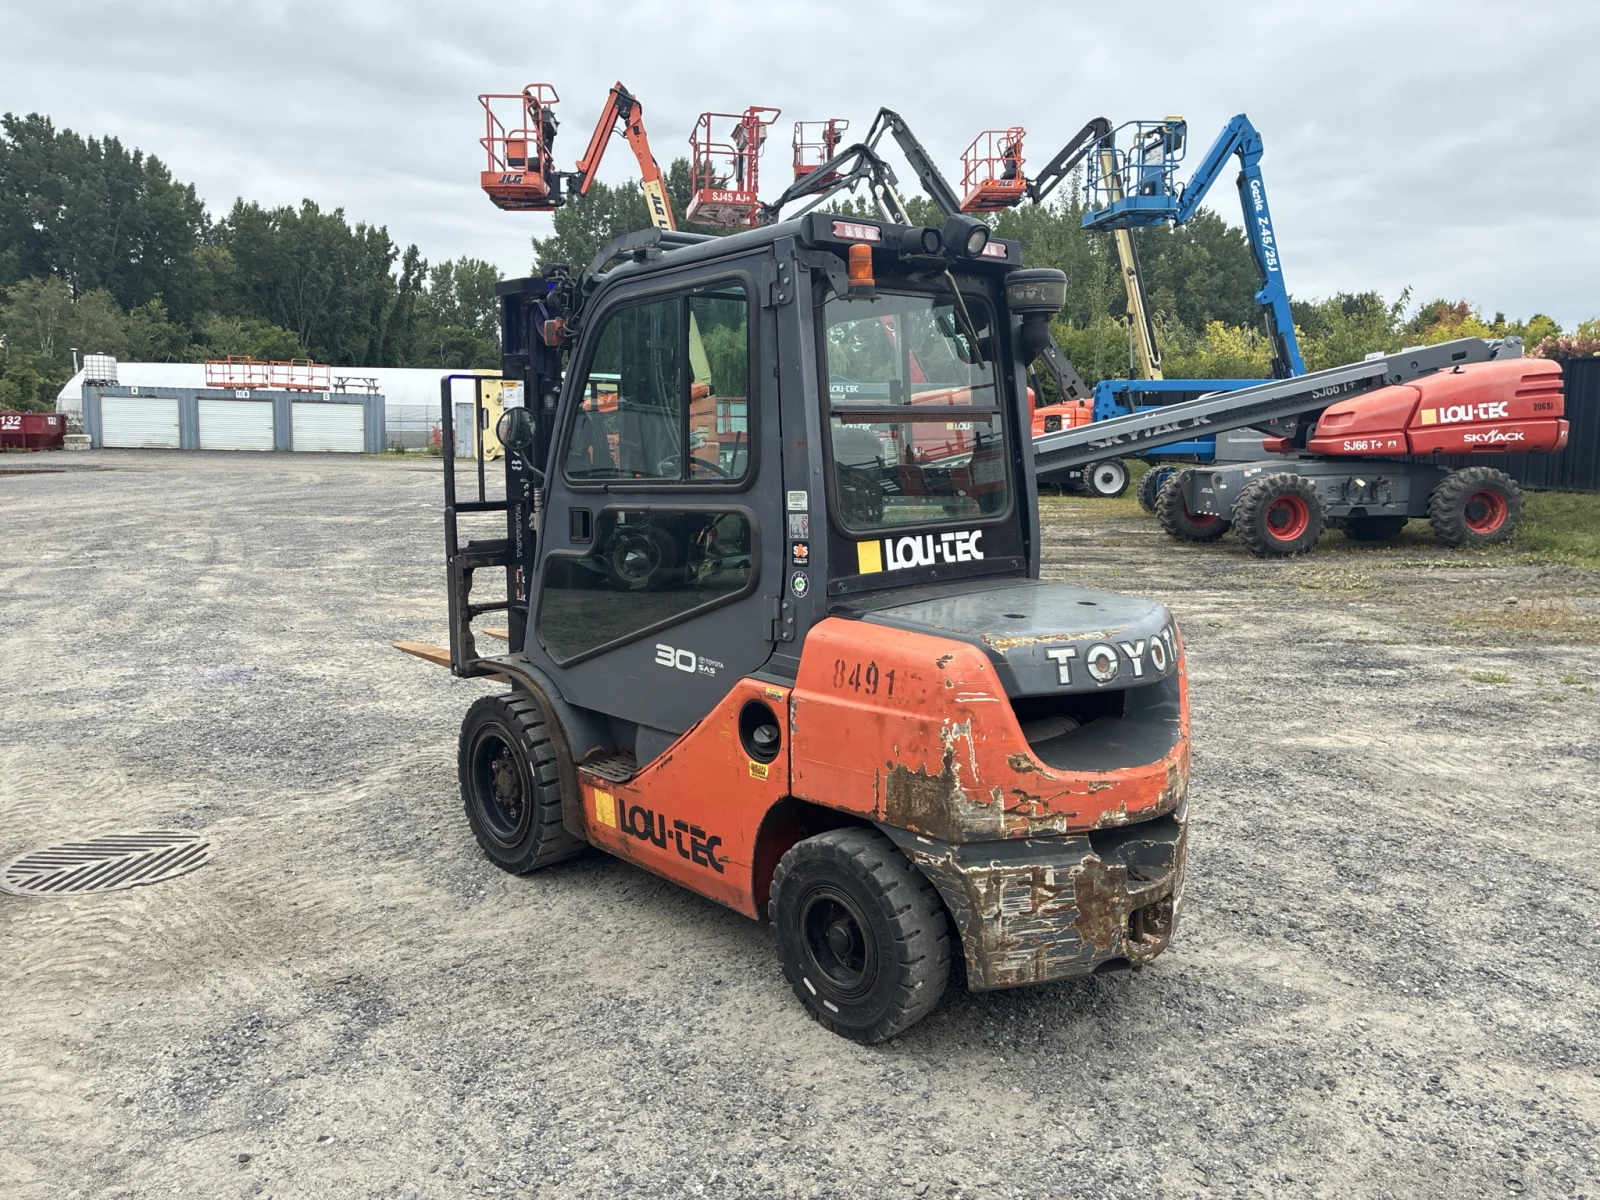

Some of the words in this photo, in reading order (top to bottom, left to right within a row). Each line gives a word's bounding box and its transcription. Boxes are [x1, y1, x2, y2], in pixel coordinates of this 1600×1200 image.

[497, 174, 524, 185] JLG
[712, 191, 734, 202] SJ45
[735, 193, 751, 203] AJ+
[650, 193, 665, 216] JLG
[1250, 180, 1264, 213] Genie
[1258, 216, 1279, 272] Z-45/25J
[1312, 385, 1340, 399] SJ66
[1439, 401, 1508, 423] LOU-TEC
[1533, 403, 1553, 411] 20651
[0, 416, 21, 425] 132
[1463, 429, 1525, 443] SKYJACK
[1343, 441, 1368, 451] SJ66
[1370, 440, 1383, 449] T+
[515, 503, 523, 558] TOYOTA
[793, 544, 808, 557] SAS
[885, 529, 984, 571] LOU-TEC
[655, 643, 697, 673] 30
[705, 658, 724, 669] TOYOTA
[698, 664, 715, 674] SAS
[833, 659, 895, 699] 8491
[619, 799, 724, 874] LOU-TEC
